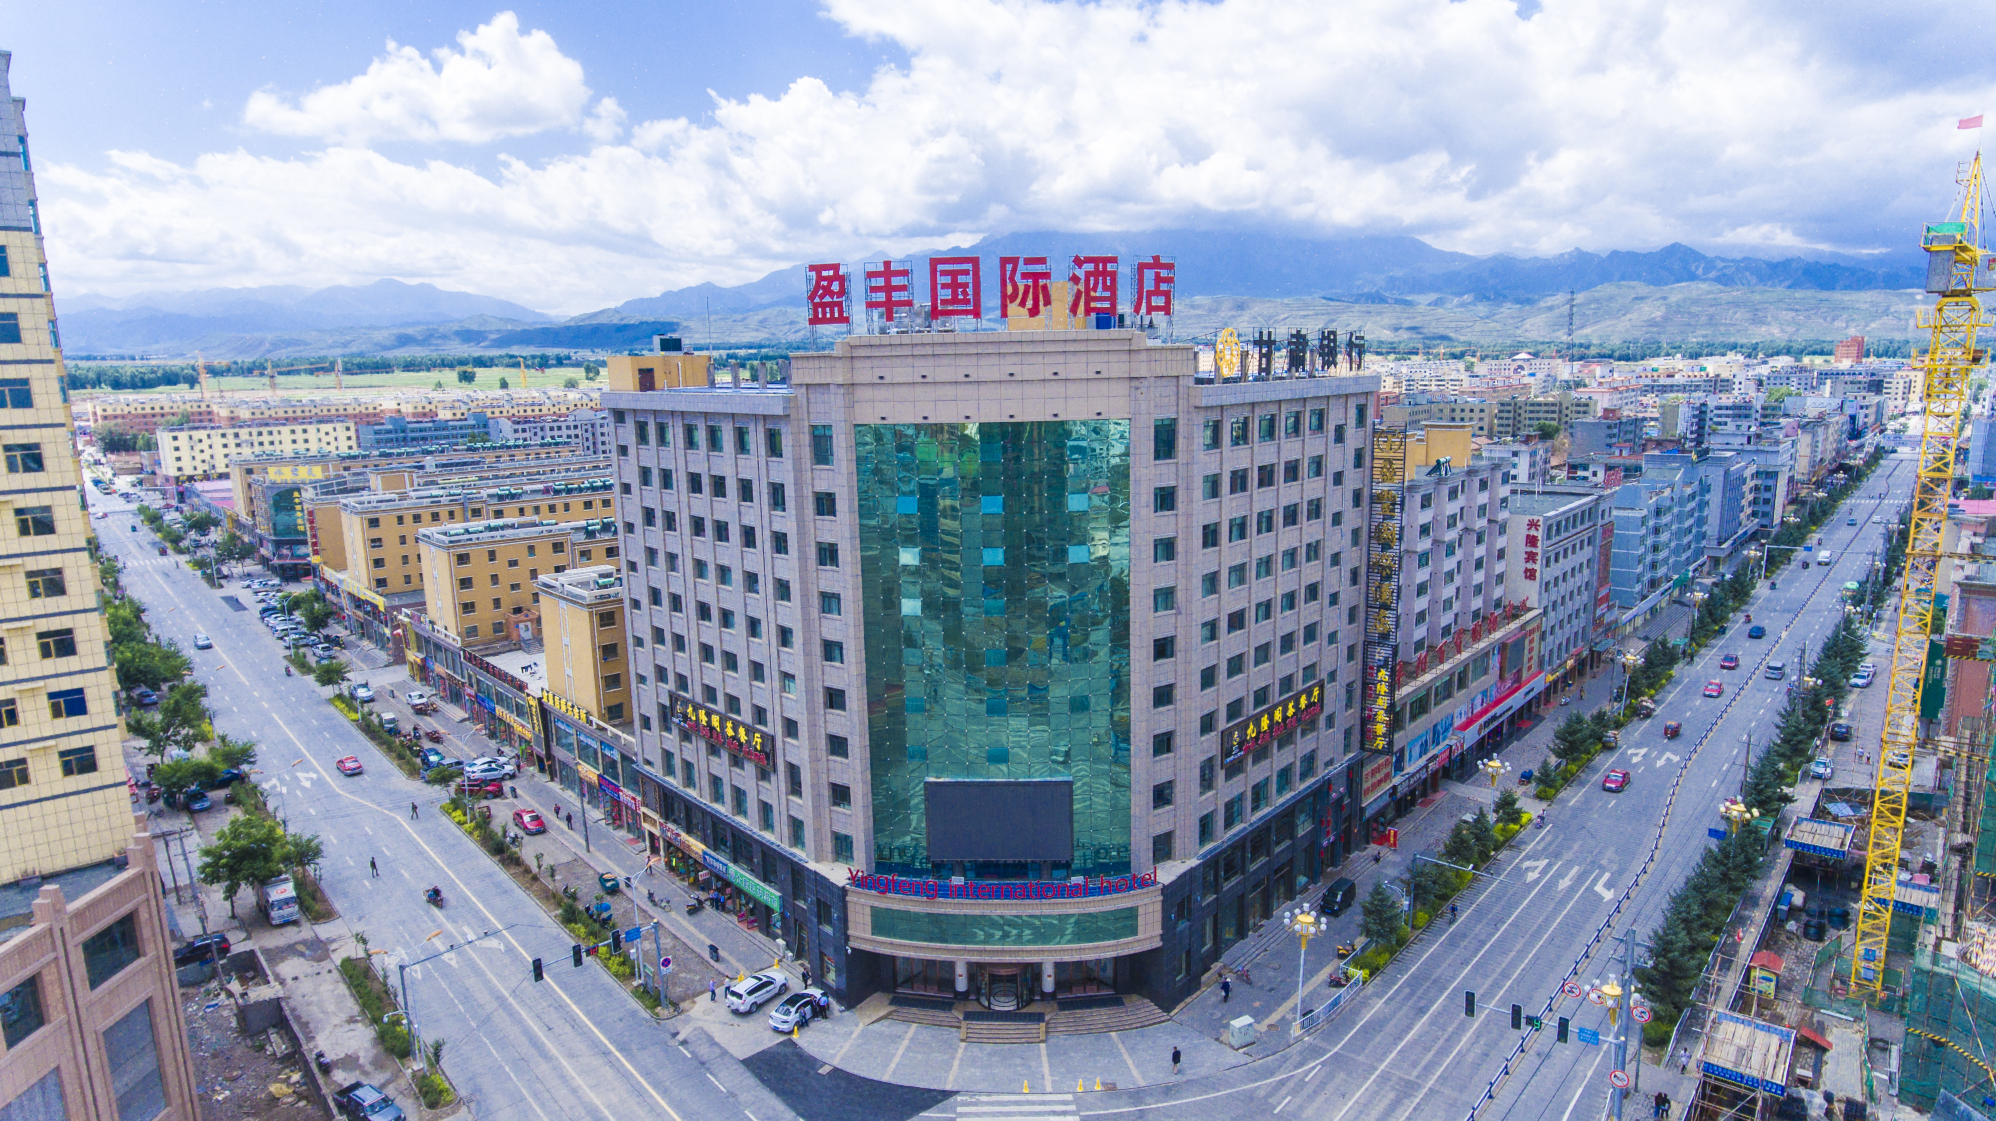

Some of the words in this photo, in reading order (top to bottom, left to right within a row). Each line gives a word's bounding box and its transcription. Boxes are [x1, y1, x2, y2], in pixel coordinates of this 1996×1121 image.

[807, 254, 1175, 325] 盈丰国际酒店
[1253, 330, 1366, 376] 甘肃银行
[1523, 518, 1542, 582] 兴隆宾馆
[847, 866, 938, 900] Yingfeng
[948, 876, 1090, 899] international
[1100, 866, 1158, 895] hotel
